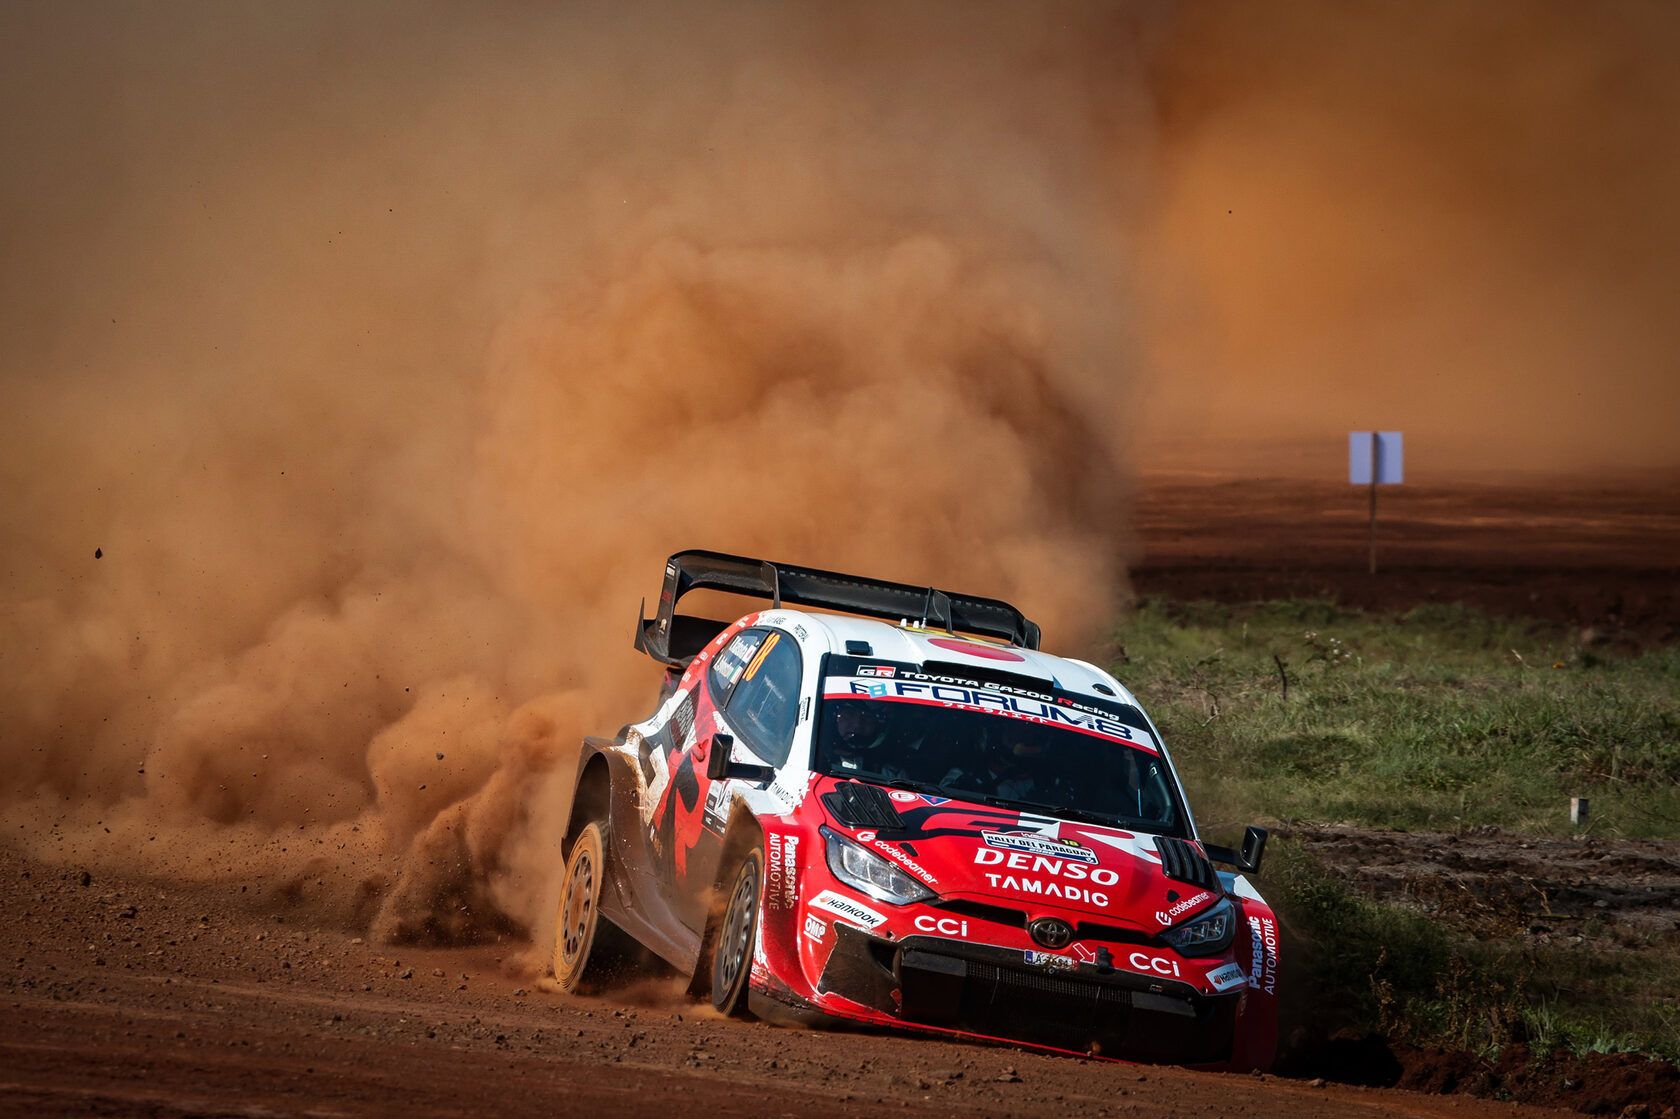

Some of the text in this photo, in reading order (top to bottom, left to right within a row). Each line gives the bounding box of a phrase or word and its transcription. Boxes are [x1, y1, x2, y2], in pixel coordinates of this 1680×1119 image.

[742, 633, 781, 681] 18
[857, 668, 895, 677] GR
[895, 682, 1133, 740] FORUM8
[901, 671, 1120, 721] TOYOTA GAZOO Racing
[875, 840, 937, 884] codebeamer
[974, 848, 1119, 886] DENSO
[1019, 839, 1037, 848] DEL
[1040, 842, 1092, 857] PARAGUAY
[769, 832, 781, 911] AUTOMOTIVE
[784, 835, 799, 910] Panasonic
[985, 873, 1109, 907] TAMADIC
[1169, 891, 1210, 917] codebeamer
[804, 918, 826, 938] OMP
[1247, 916, 1263, 989] Panasonic
[1262, 917, 1277, 996] AUTOMOTIVE
